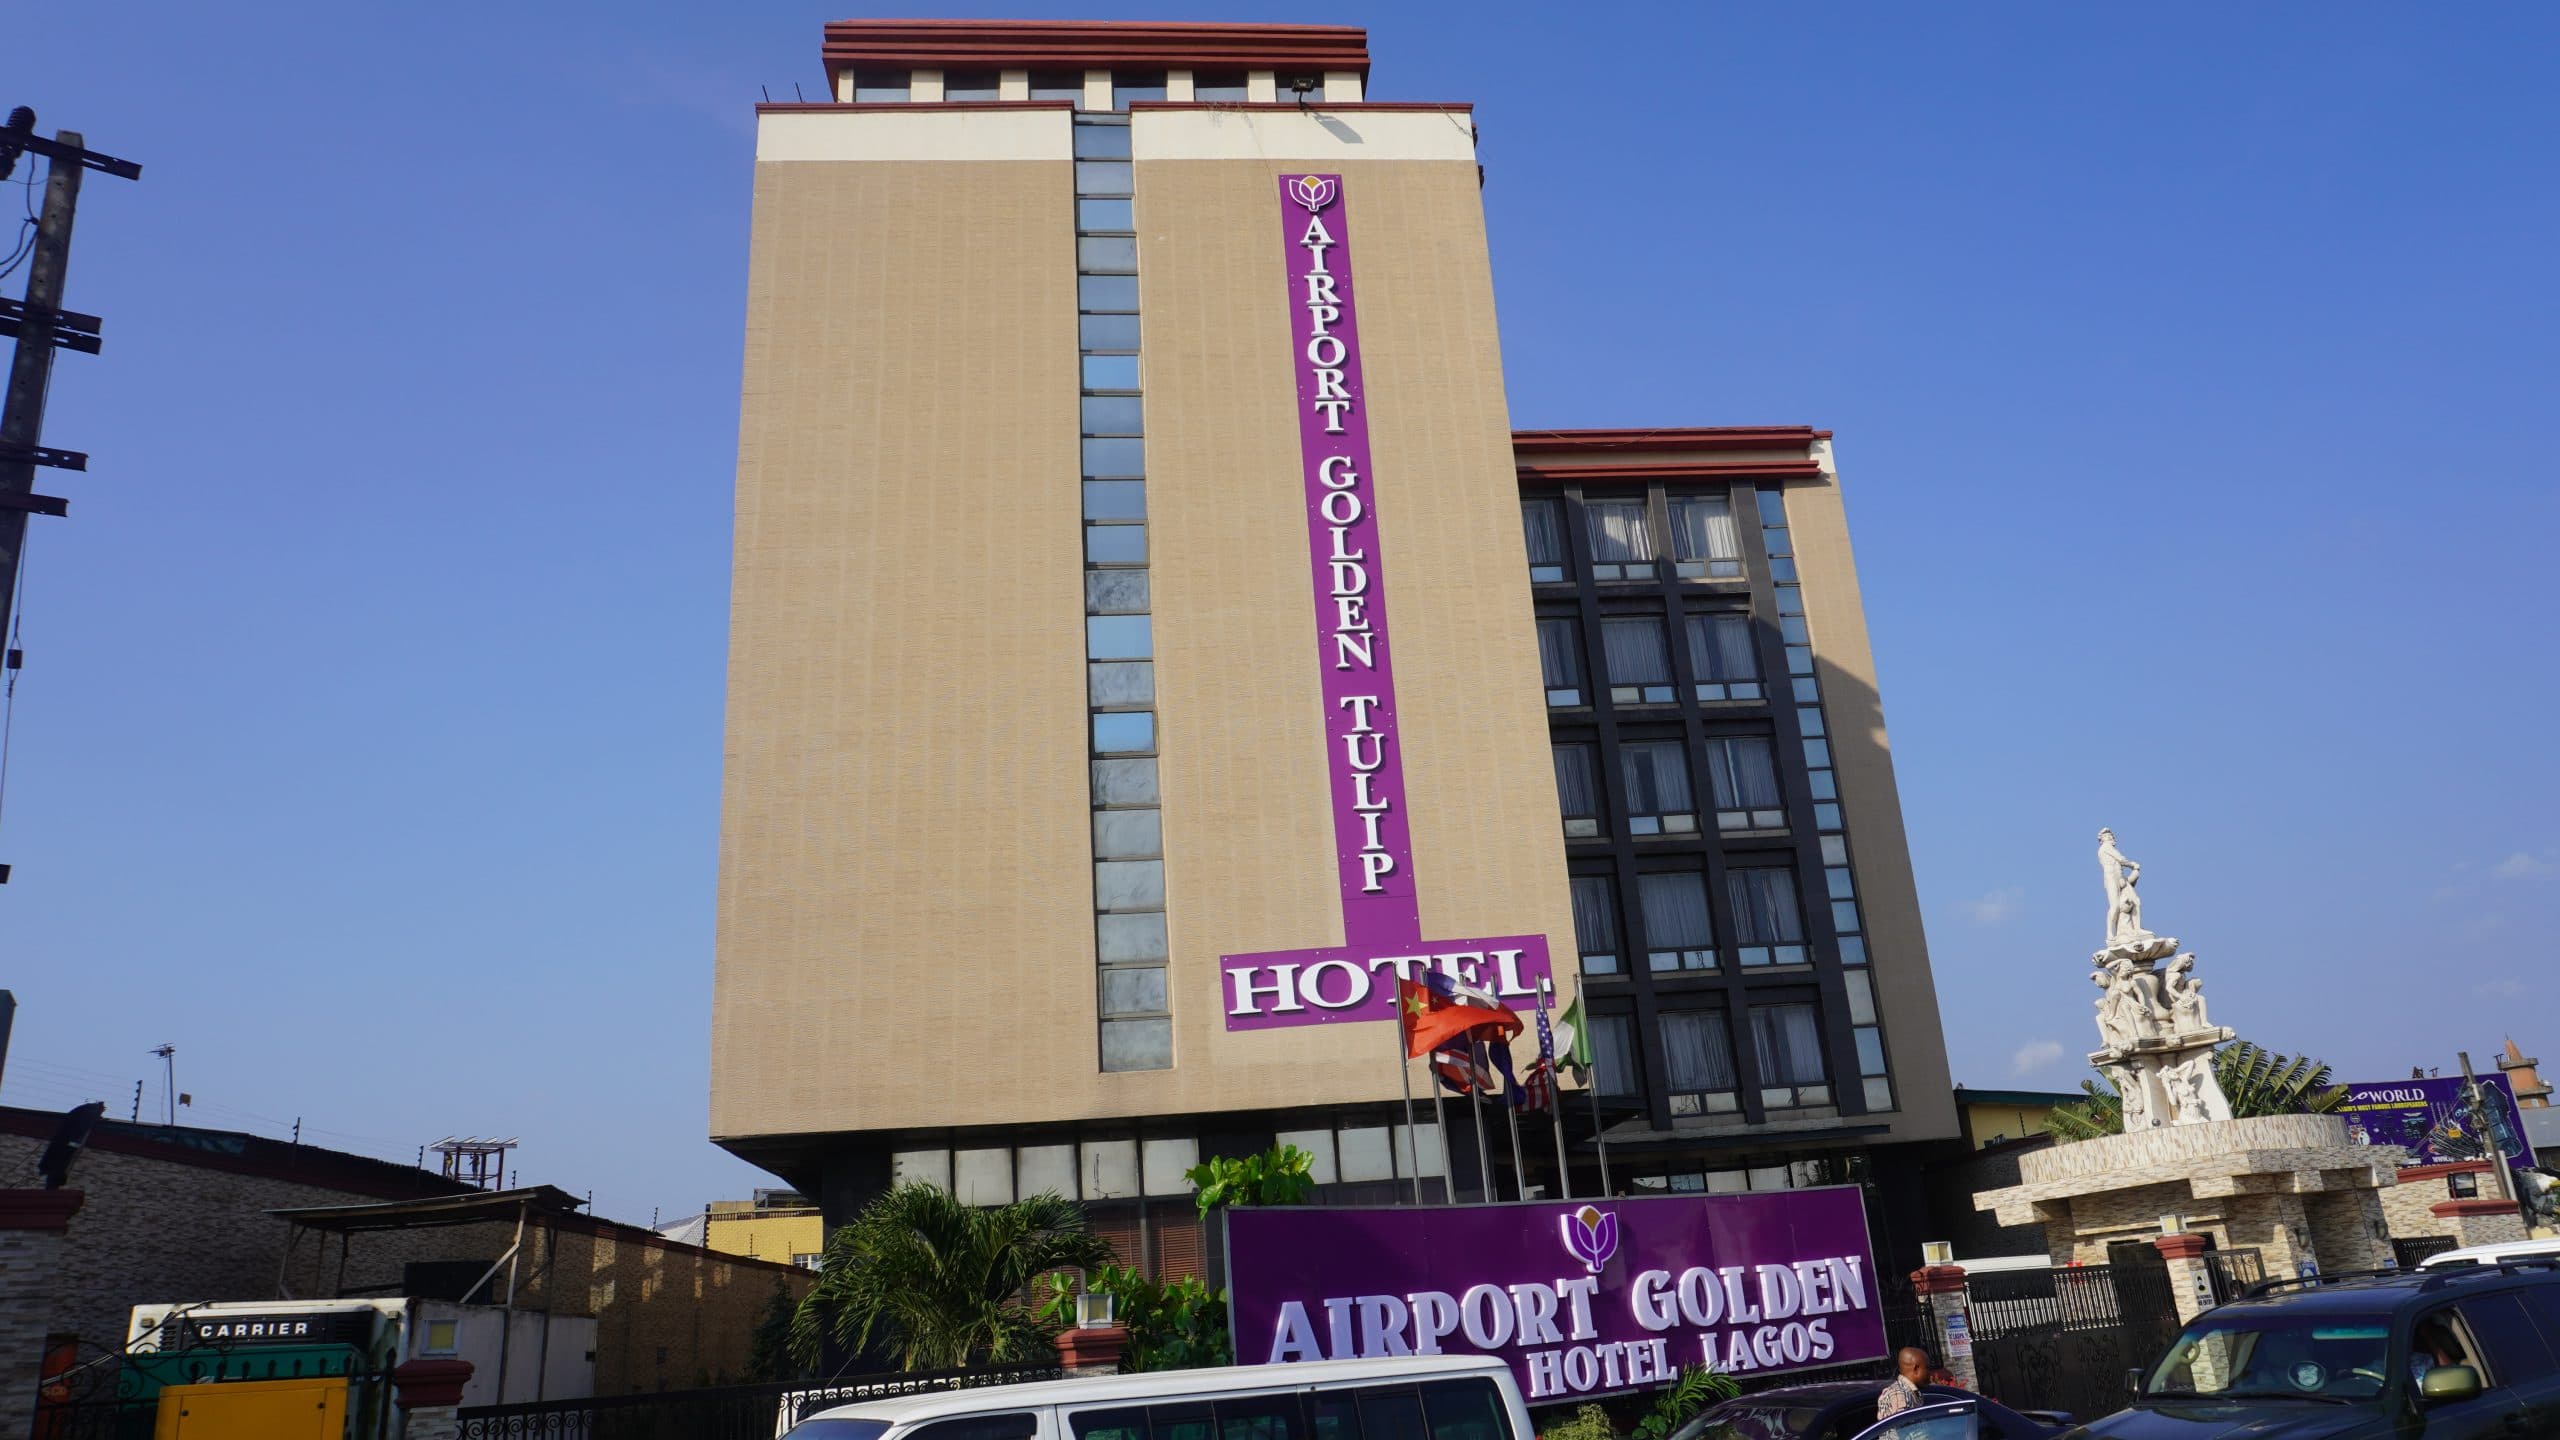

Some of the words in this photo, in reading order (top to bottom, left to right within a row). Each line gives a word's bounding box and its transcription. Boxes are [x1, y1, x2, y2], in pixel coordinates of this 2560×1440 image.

[1300, 215, 1351, 432] AIRPORT
[1319, 456, 1373, 668] GOLDEN
[1340, 695, 1394, 892] TULIP
[200, 1322, 308, 1337] CARRIER
[1266, 1276, 1600, 1364] AIRPORT
[1631, 1255, 1867, 1332] GOLDEN
[1525, 1338, 1678, 1398] HOTEL
[1698, 1318, 1834, 1375] LAGOS
